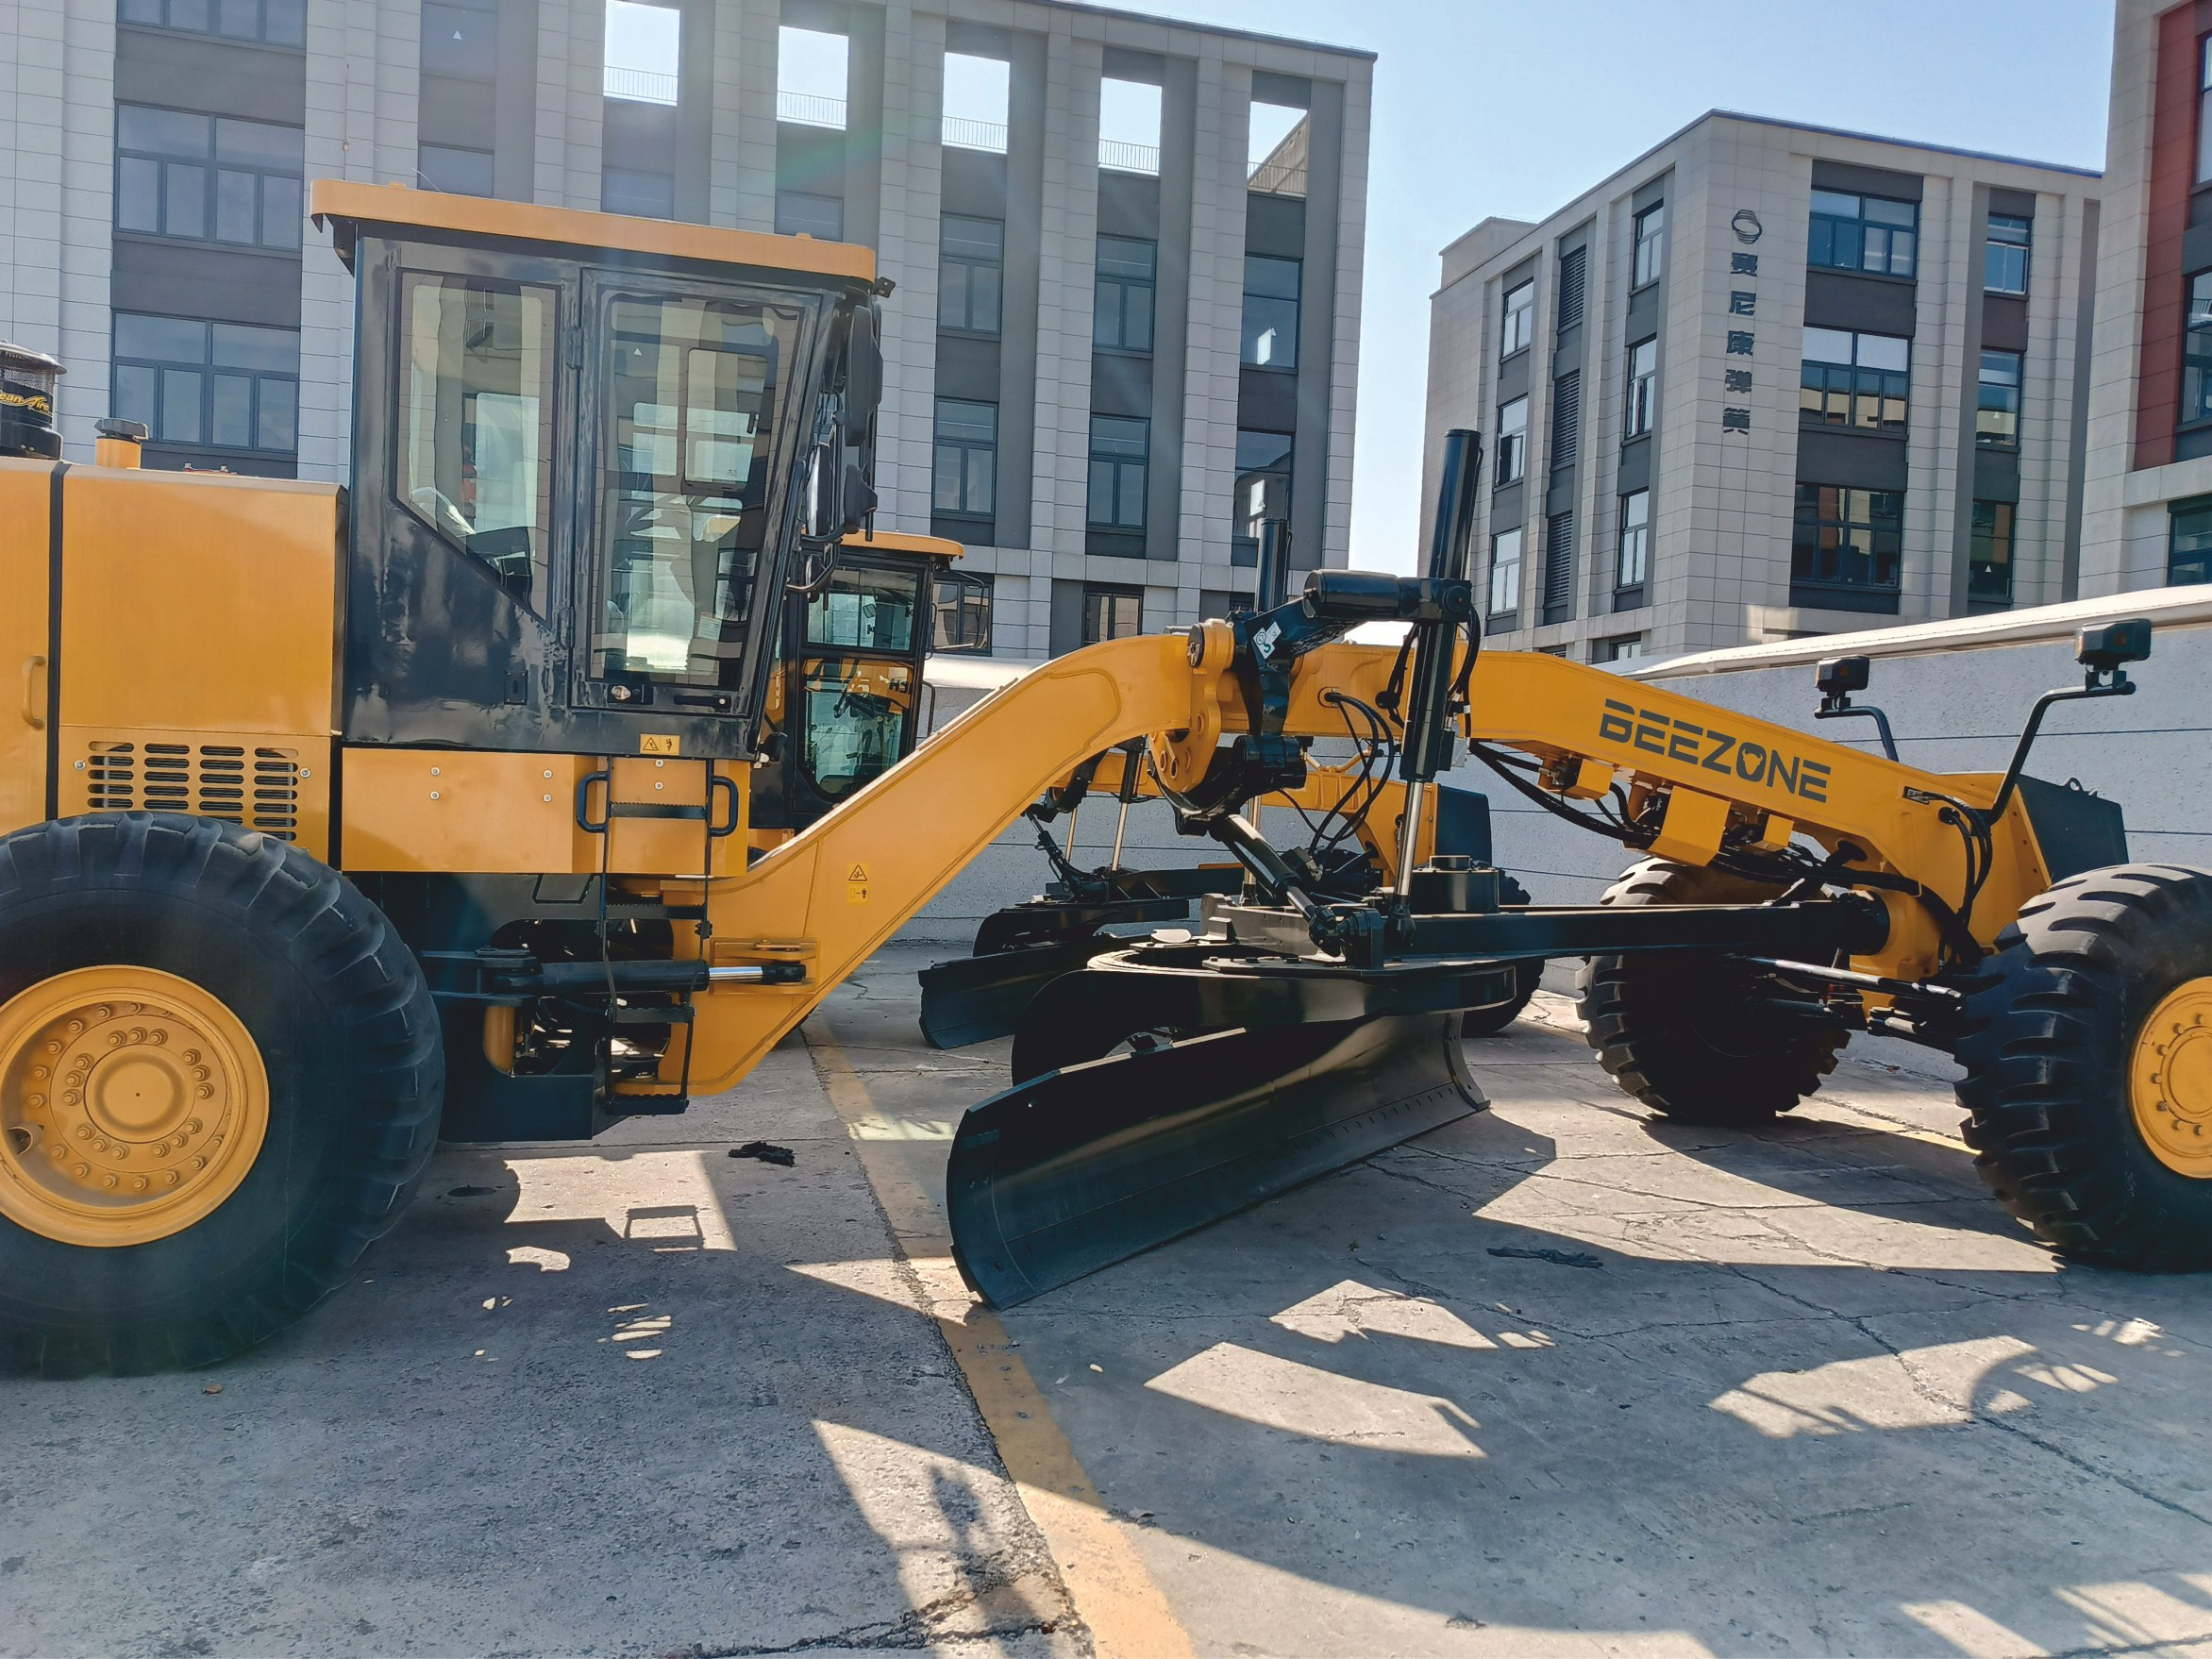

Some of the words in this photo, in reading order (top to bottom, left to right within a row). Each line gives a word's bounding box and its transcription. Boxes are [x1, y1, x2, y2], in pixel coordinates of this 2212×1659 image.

[1722, 252, 1758, 435] 赛尼康弹簧
[1600, 699, 1831, 803] BEEZONE
